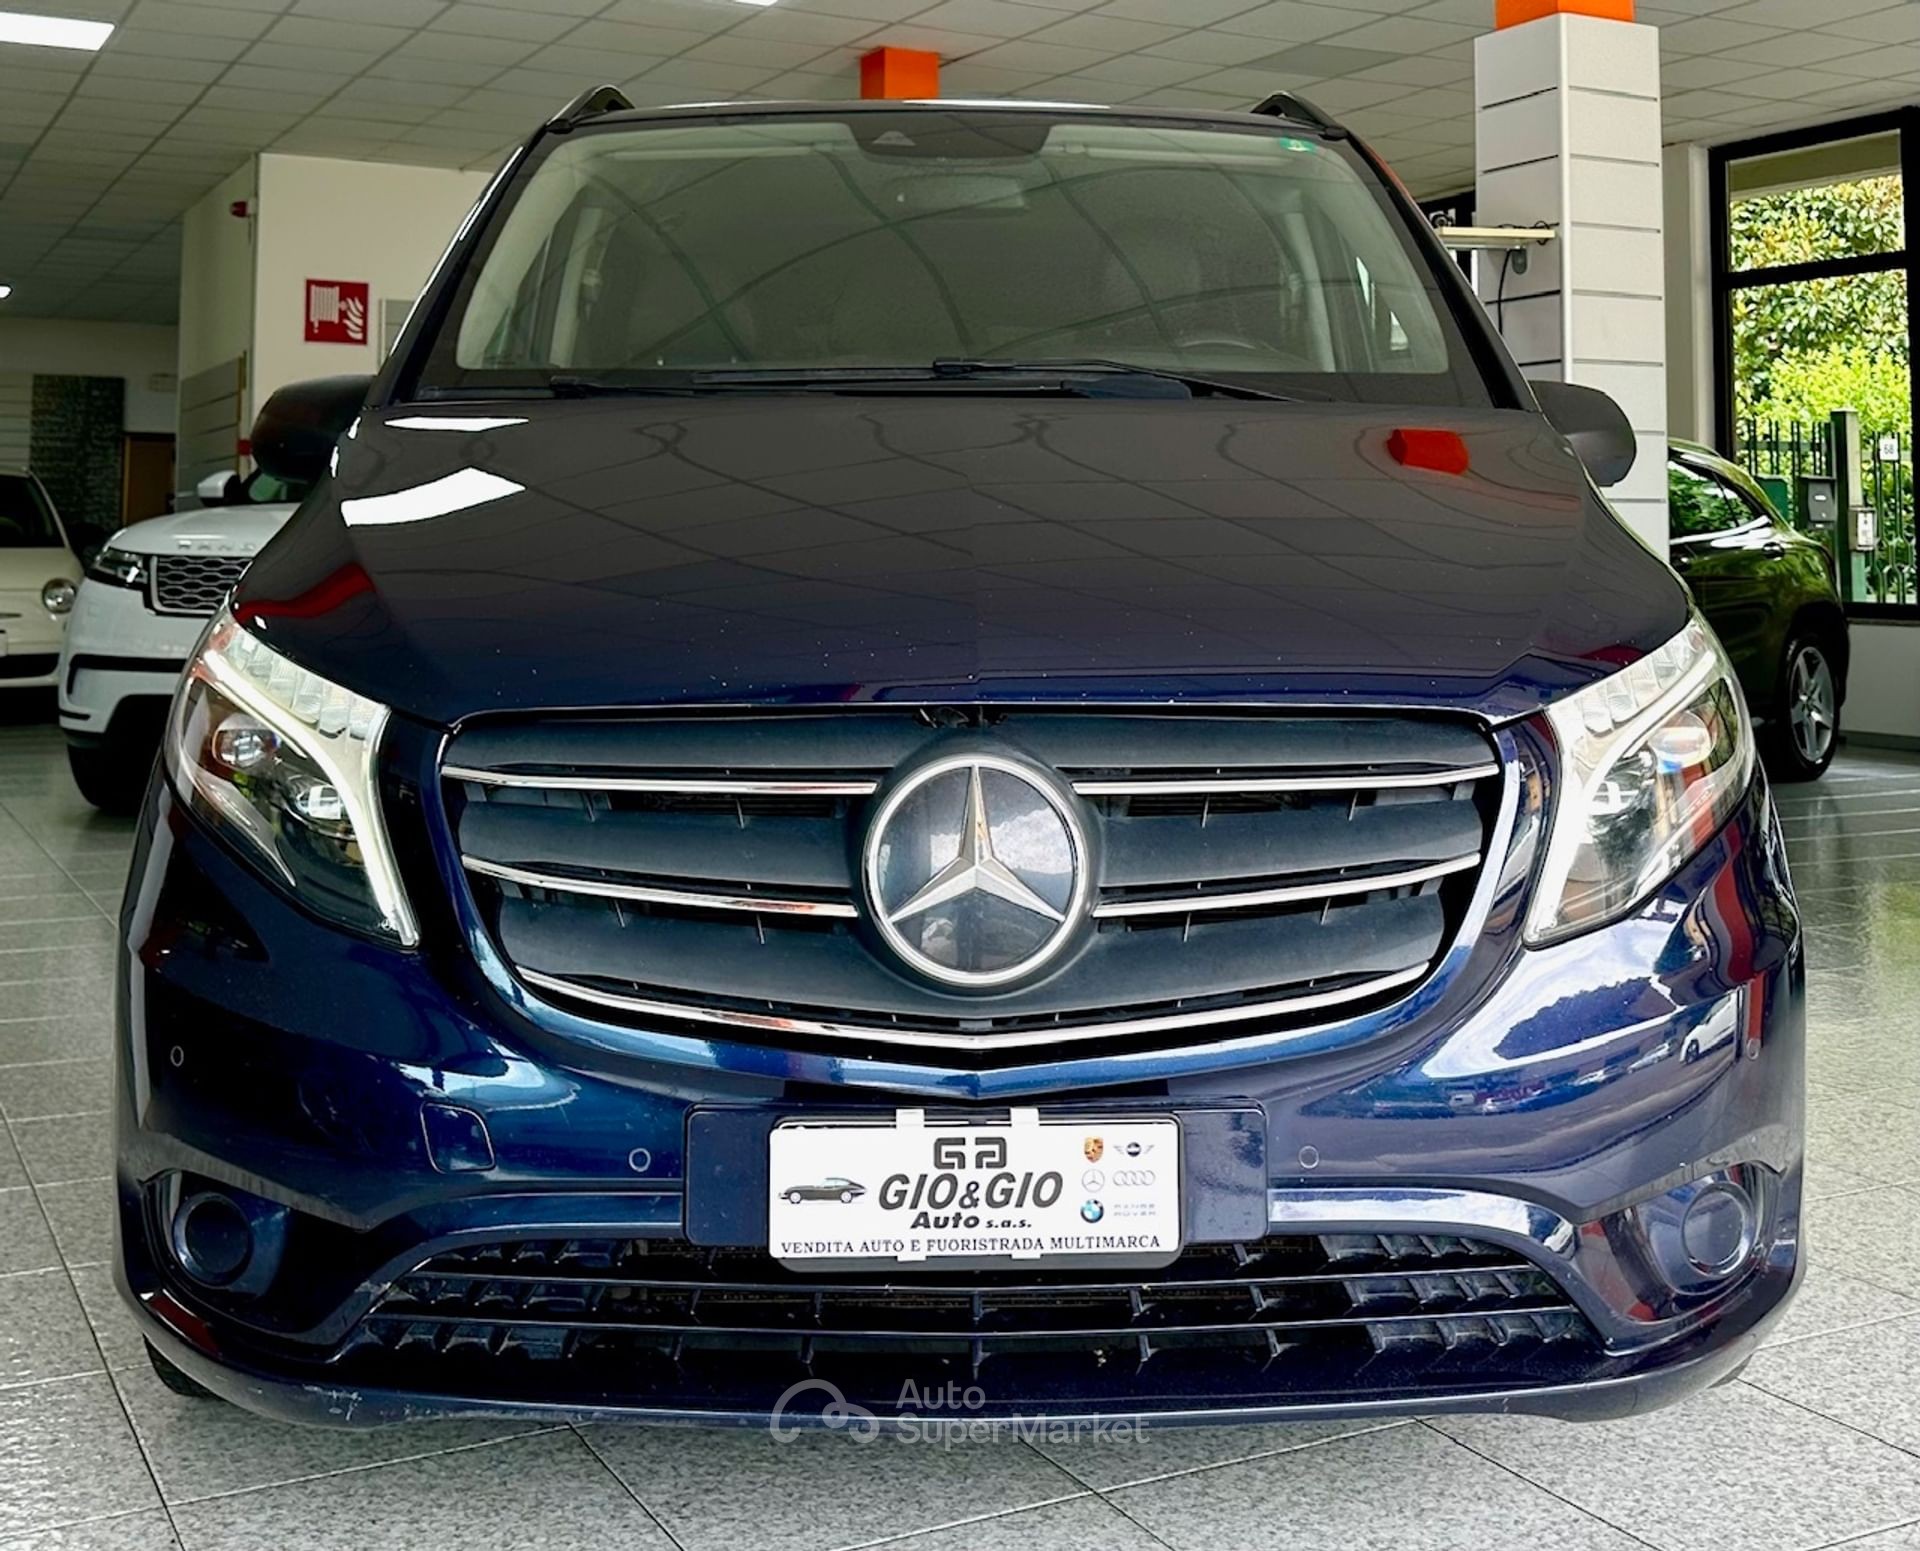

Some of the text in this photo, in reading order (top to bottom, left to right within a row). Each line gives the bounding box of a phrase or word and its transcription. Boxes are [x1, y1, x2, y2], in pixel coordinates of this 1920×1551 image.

[878, 1171, 1063, 1210] GIO&GIO
[910, 1211, 1032, 1229] Auto s.a.s.
[781, 1235, 1161, 1253] VENDITA AUTO E FUORISTRADA MULTIMARCA
